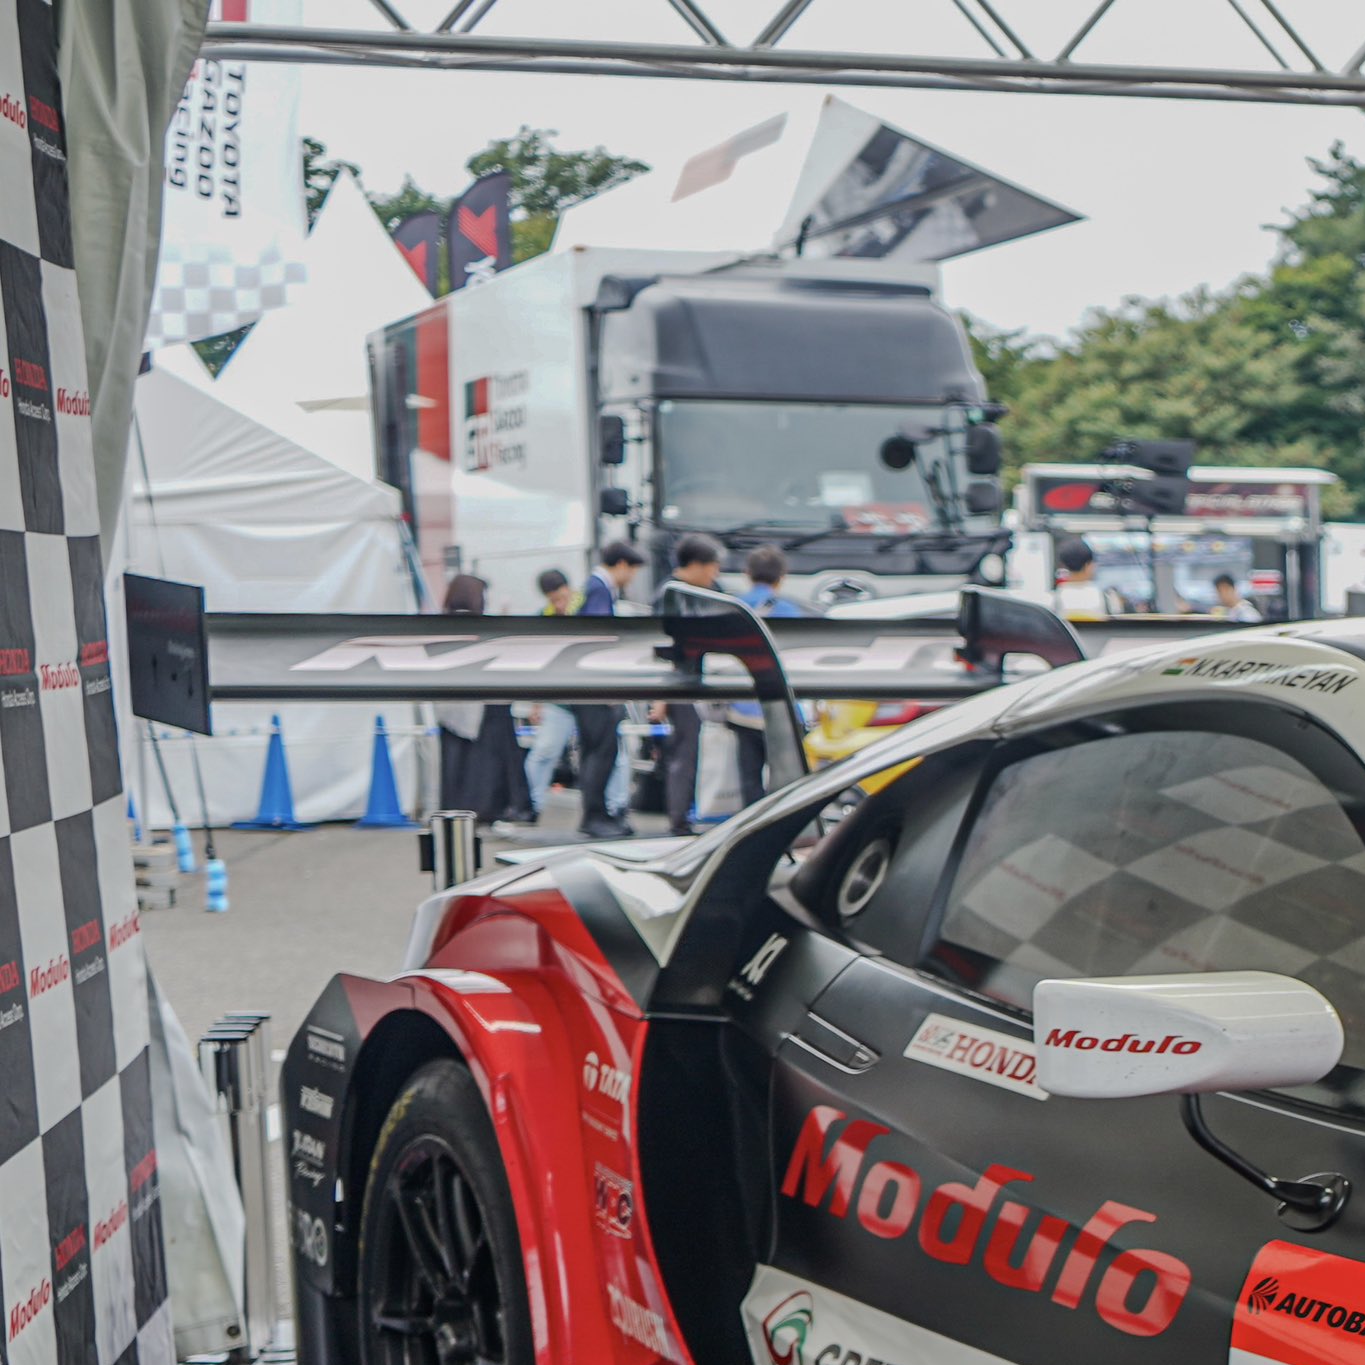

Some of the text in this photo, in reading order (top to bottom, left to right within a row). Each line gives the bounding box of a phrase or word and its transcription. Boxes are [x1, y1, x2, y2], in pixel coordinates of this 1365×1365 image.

[0, 93, 26, 130] dulo
[200, 60, 222, 200] GAZOO
[223, 65, 246, 217] TOYOTA
[40, 661, 79, 691] Modulo
[30, 954, 69, 999] Modulo
[1045, 1028, 1203, 1055] Modulo
[780, 1105, 1193, 1337] Modulo
[8, 1278, 51, 1344] Modulo
